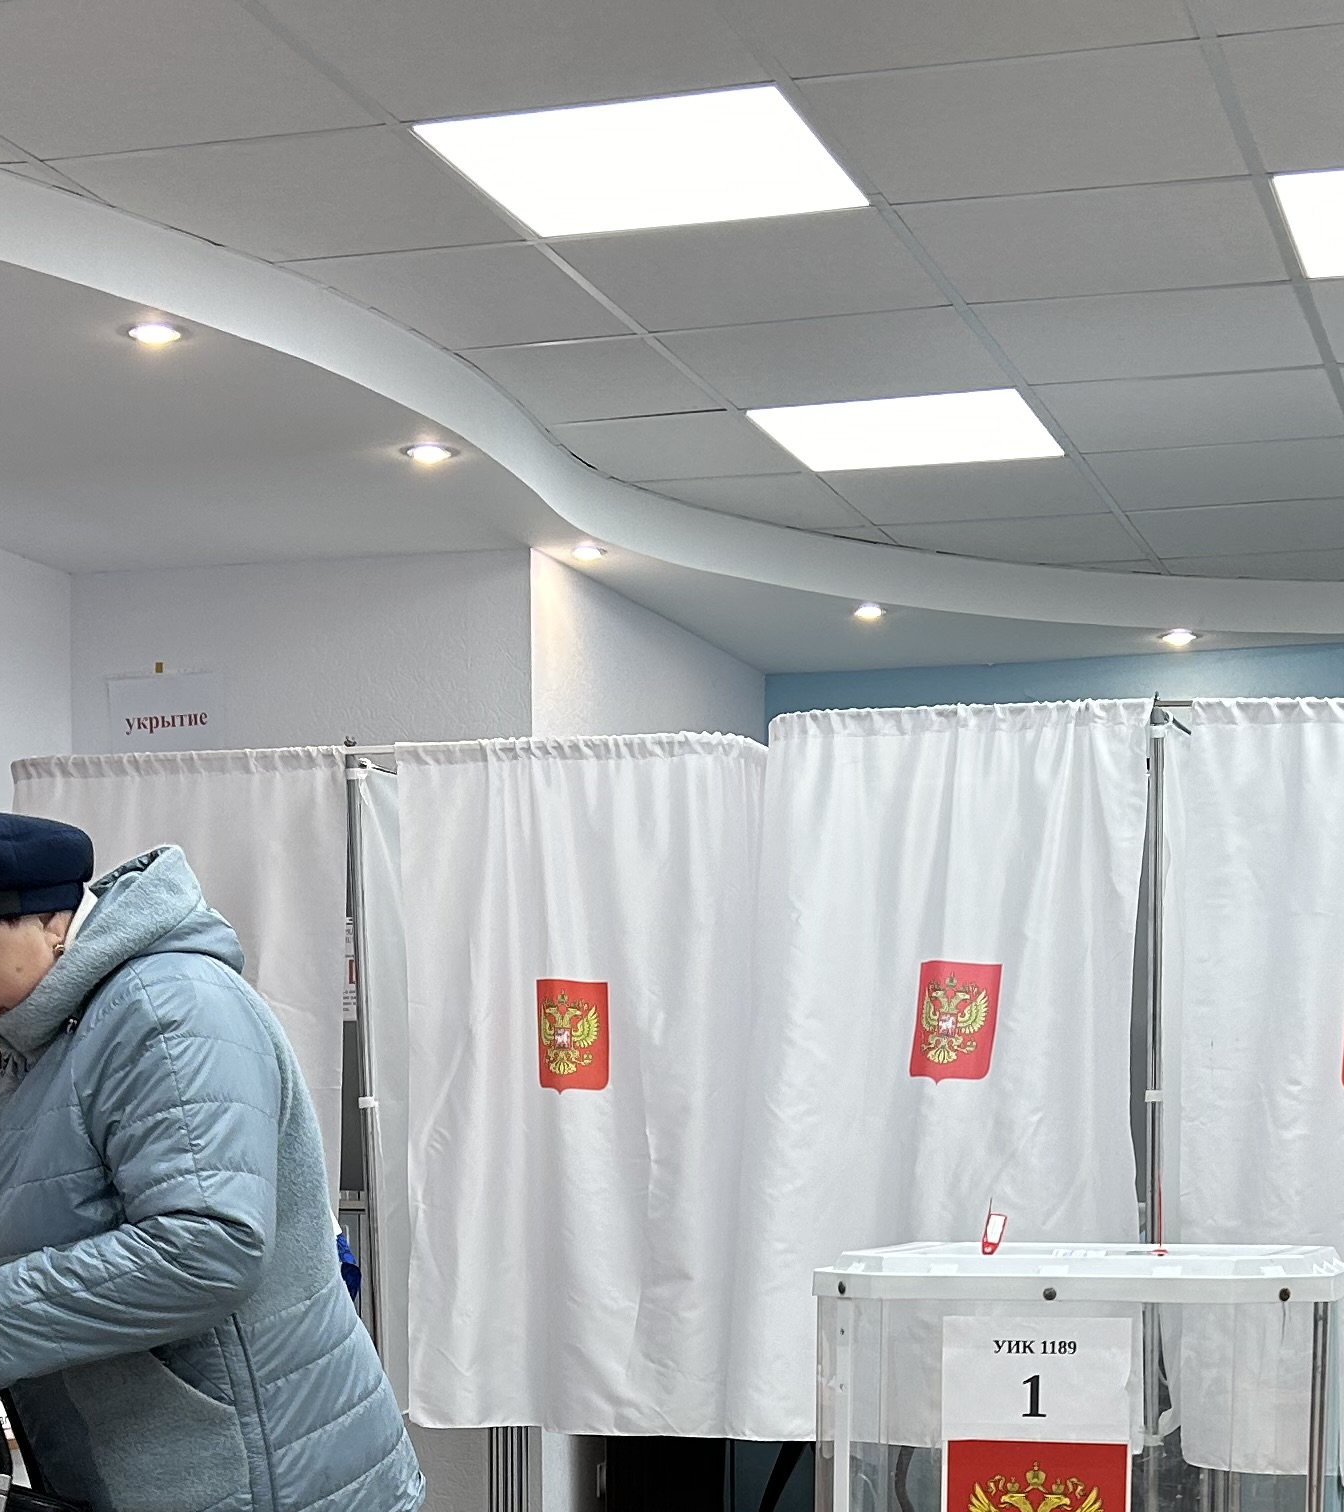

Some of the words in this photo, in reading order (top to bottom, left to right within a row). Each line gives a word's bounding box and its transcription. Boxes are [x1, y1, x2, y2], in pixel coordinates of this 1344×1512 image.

[125, 711, 208, 735] укрытие
[993, 1339, 1036, 1355] УИК
[1040, 1339, 1078, 1356] 1189
[1021, 1374, 1047, 1418] 1
